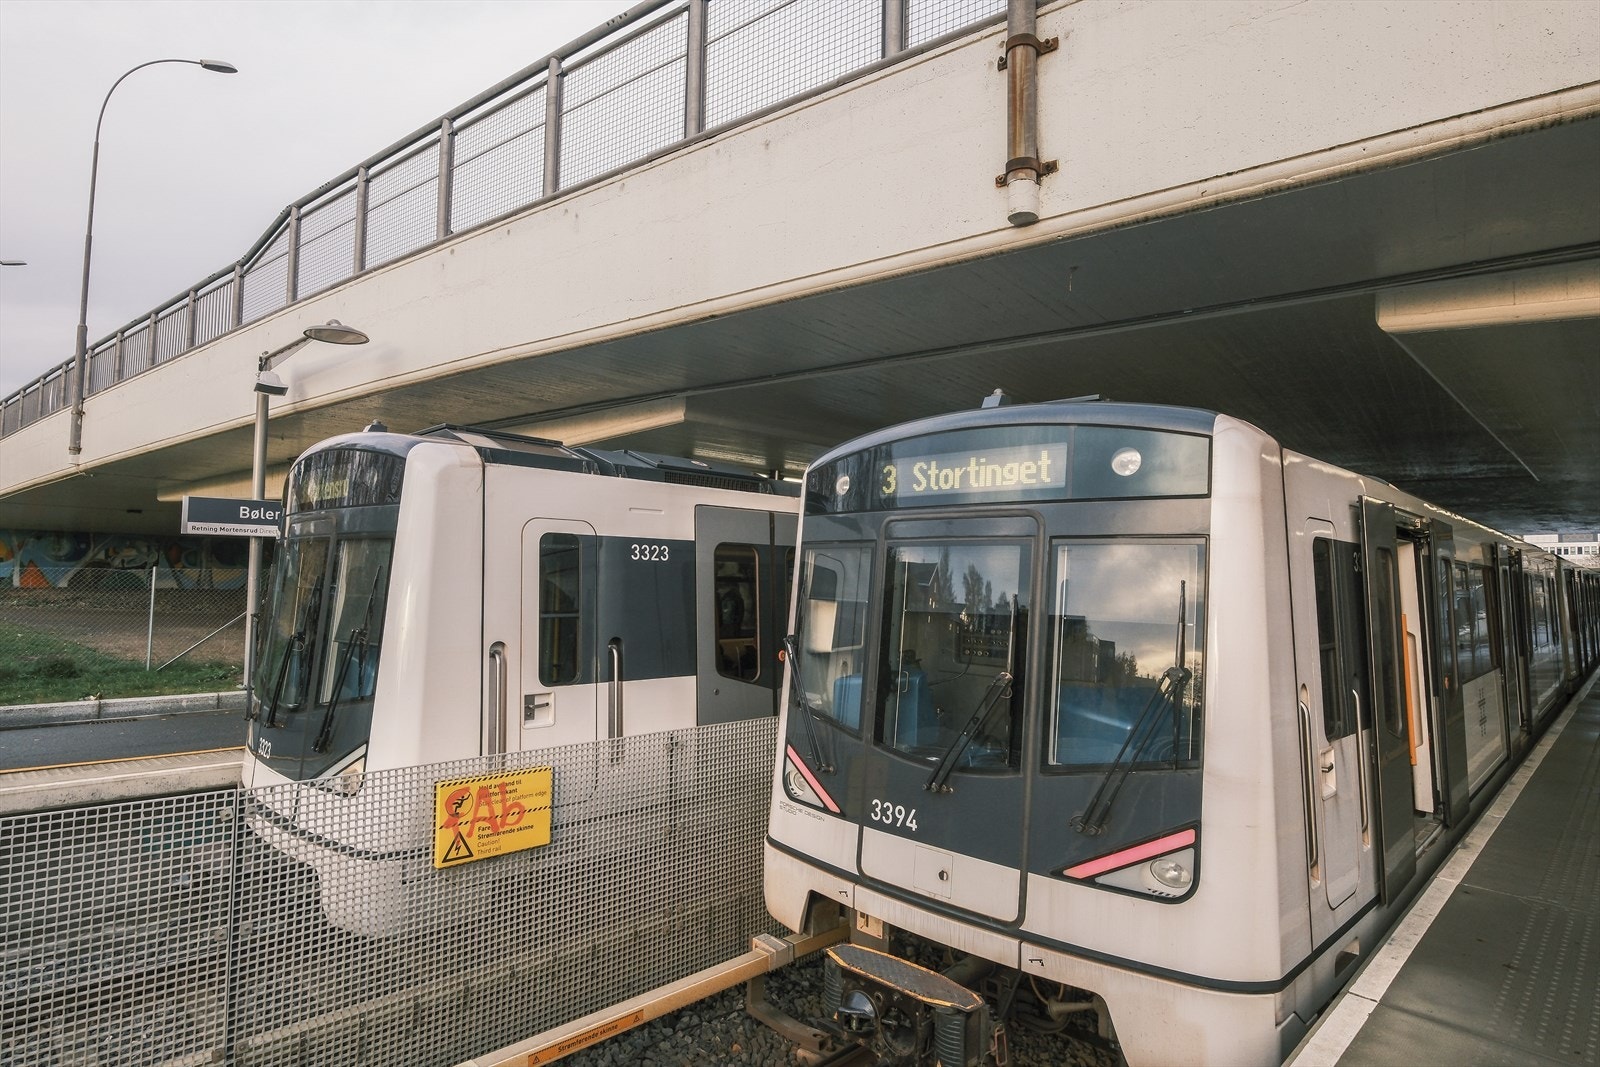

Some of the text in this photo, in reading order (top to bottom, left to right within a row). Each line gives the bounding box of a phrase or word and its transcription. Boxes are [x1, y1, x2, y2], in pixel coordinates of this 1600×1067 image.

[882, 450, 1052, 494] 3 Stortinget
[239, 506, 281, 520] Bøler
[191, 525, 218, 533] Retning
[219, 526, 258, 534] Mortensrud
[631, 544, 669, 561] 3323
[870, 799, 918, 832] 3394
